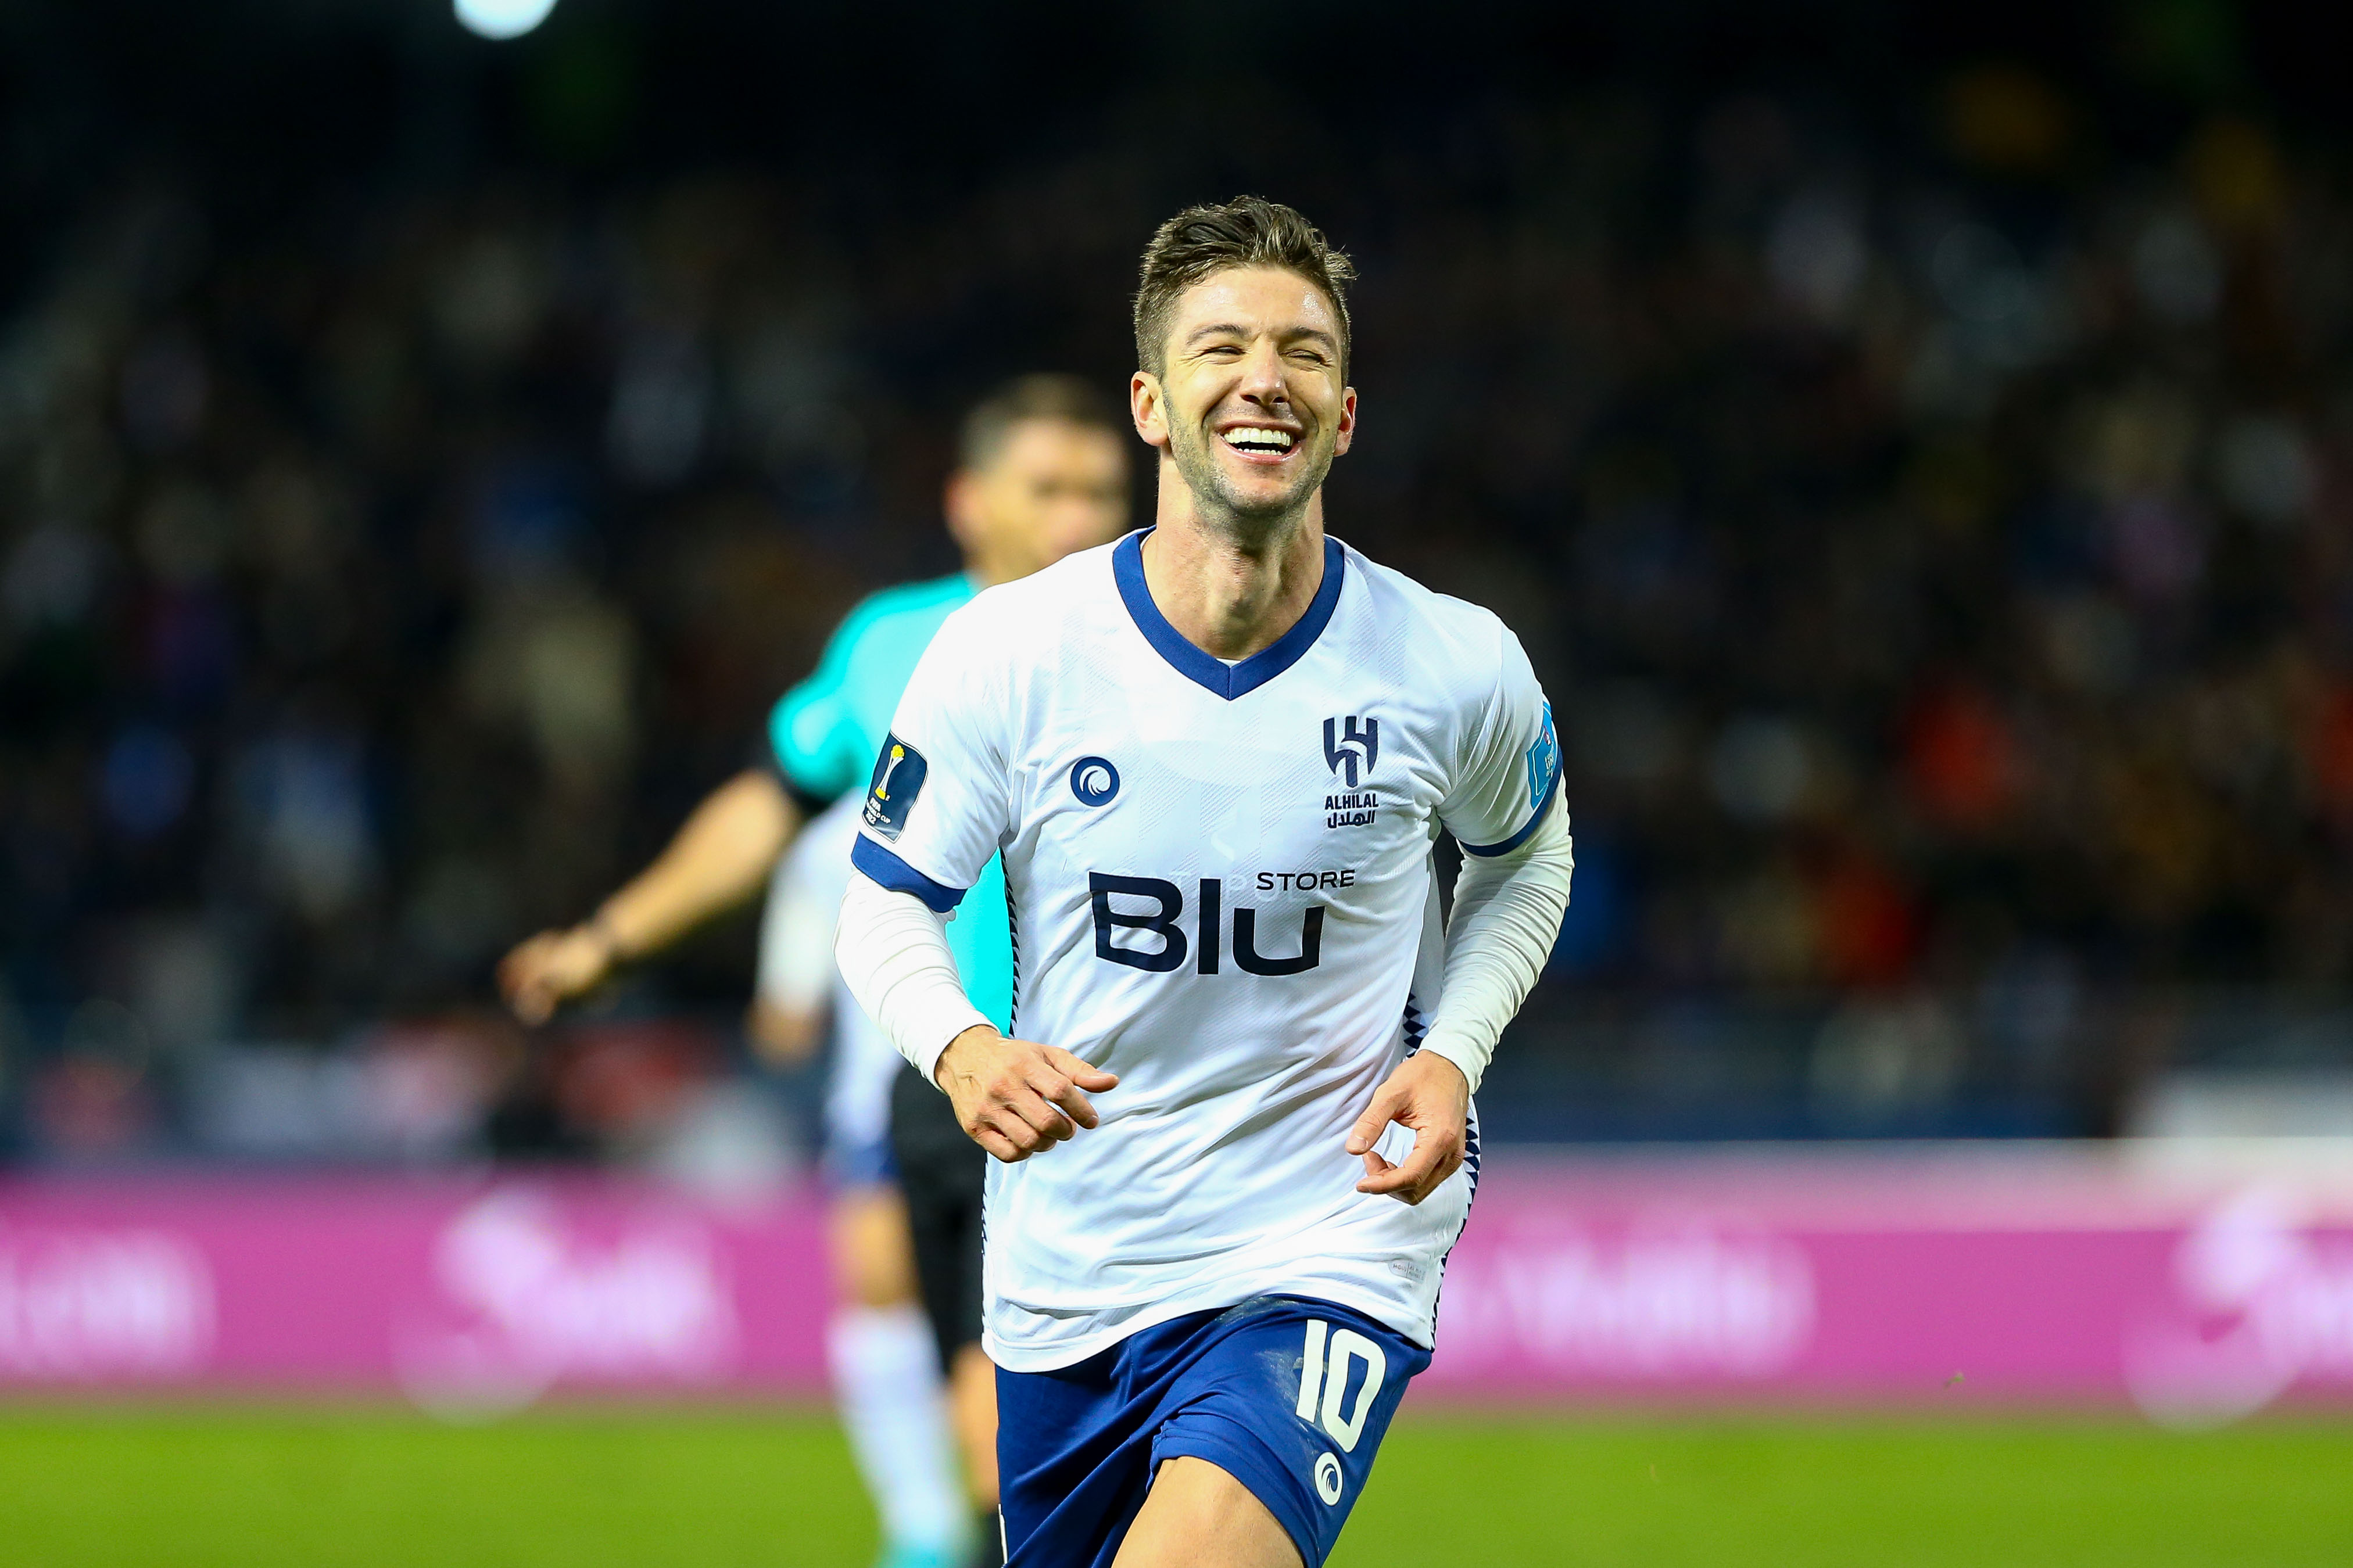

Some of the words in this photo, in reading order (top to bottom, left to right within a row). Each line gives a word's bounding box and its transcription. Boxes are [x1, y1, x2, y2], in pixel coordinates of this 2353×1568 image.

[869, 796, 881, 812] FIFA
[1324, 793, 1379, 810] ALHILAL
[880, 815, 891, 824] CUP
[1327, 810, 1376, 829] الهلال
[1256, 869, 1355, 892] STORE
[1295, 1319, 1387, 1453] 10
